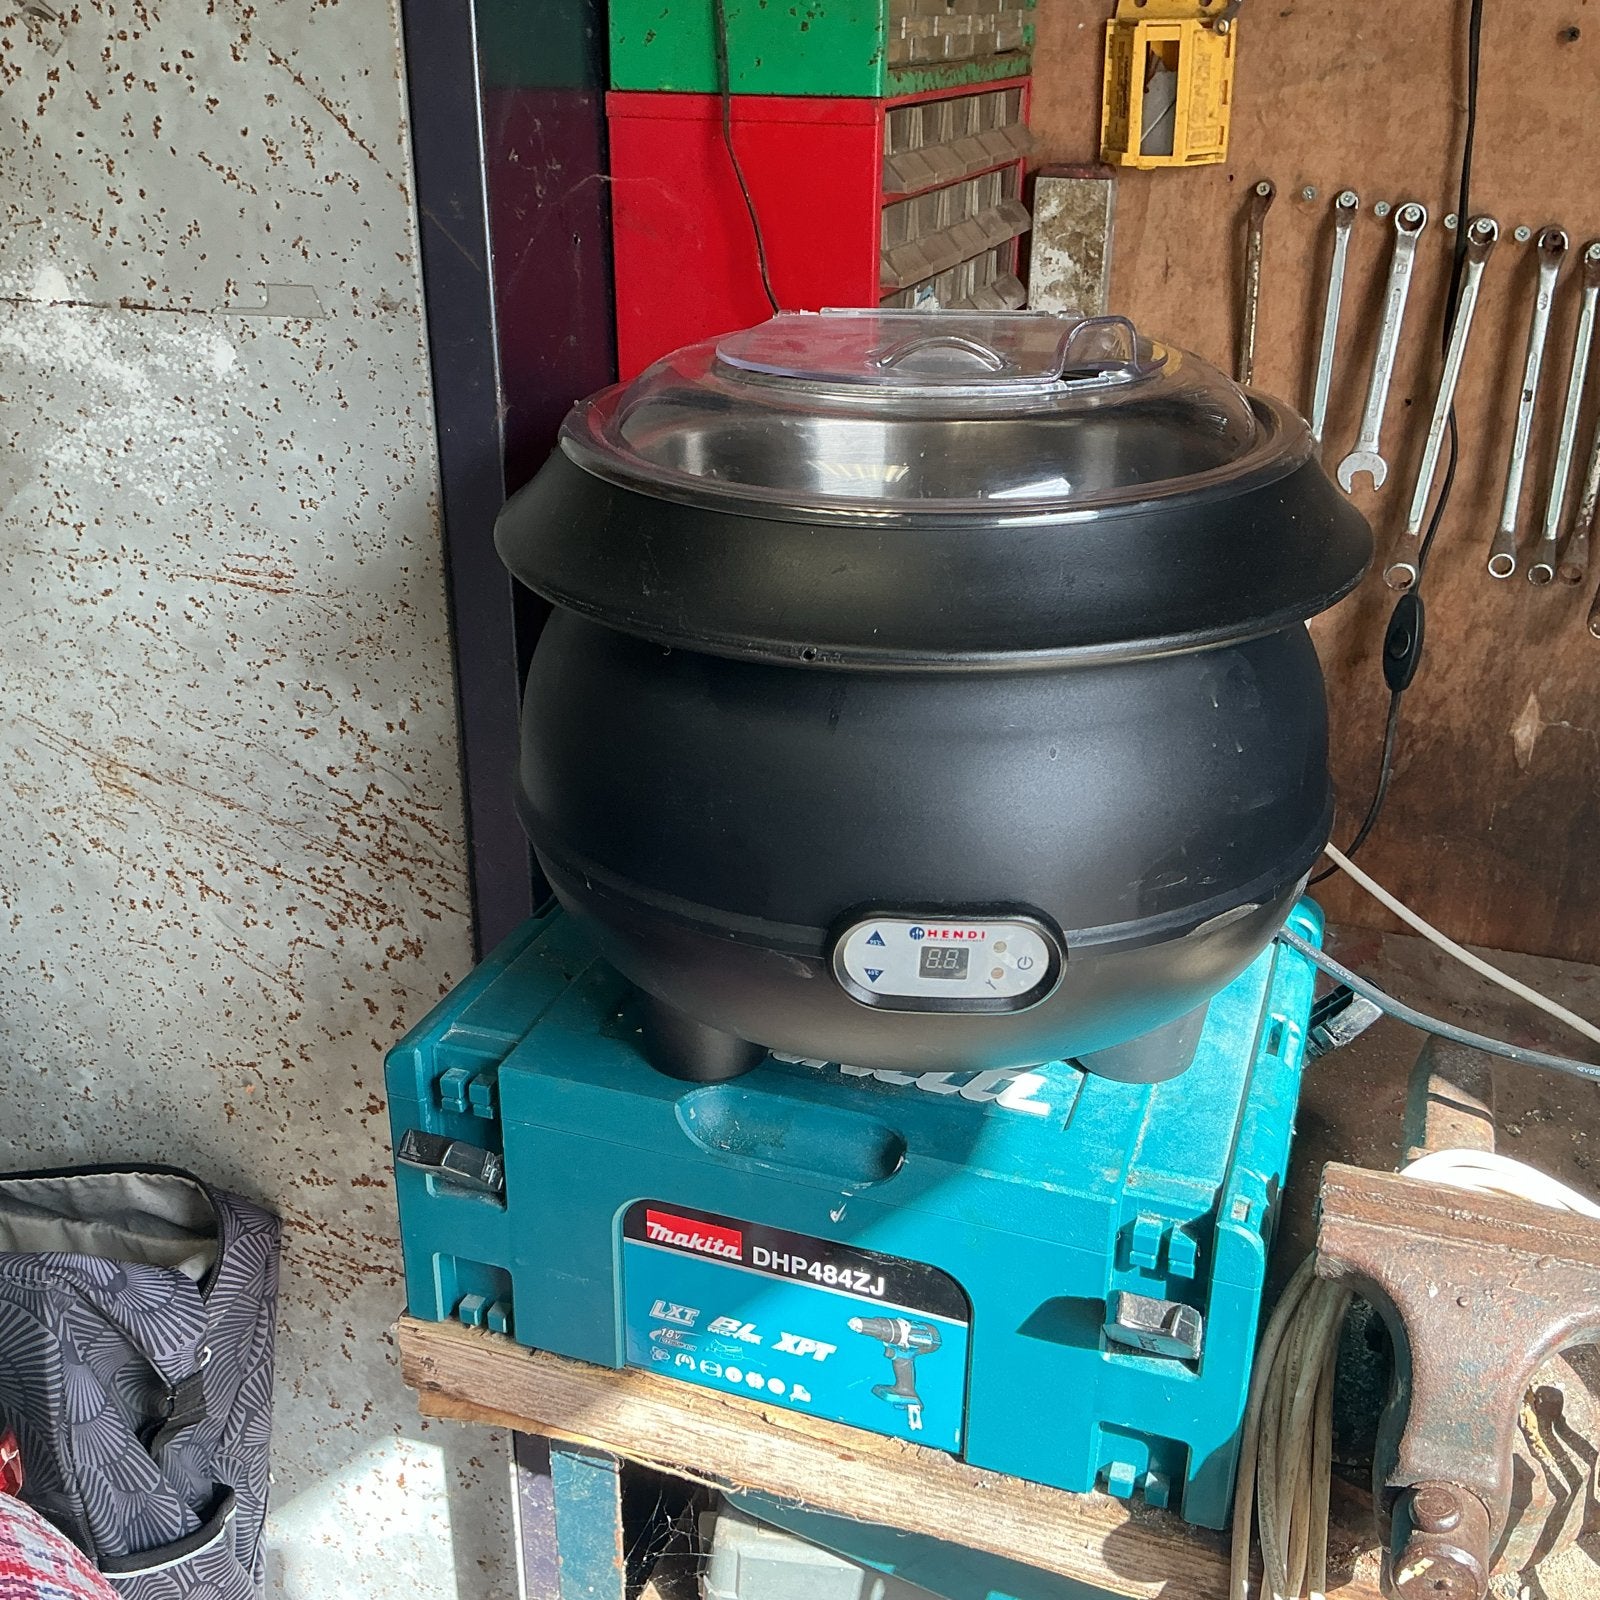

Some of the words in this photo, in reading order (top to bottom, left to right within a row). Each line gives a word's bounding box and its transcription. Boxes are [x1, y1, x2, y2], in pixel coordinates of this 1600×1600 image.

[928, 930, 985, 939] HENDI
[647, 1221, 742, 1260] Makita
[752, 1246, 885, 1296] DHP484ZJ
[649, 1300, 700, 1327] LXT
[771, 1332, 838, 1362] XPT
